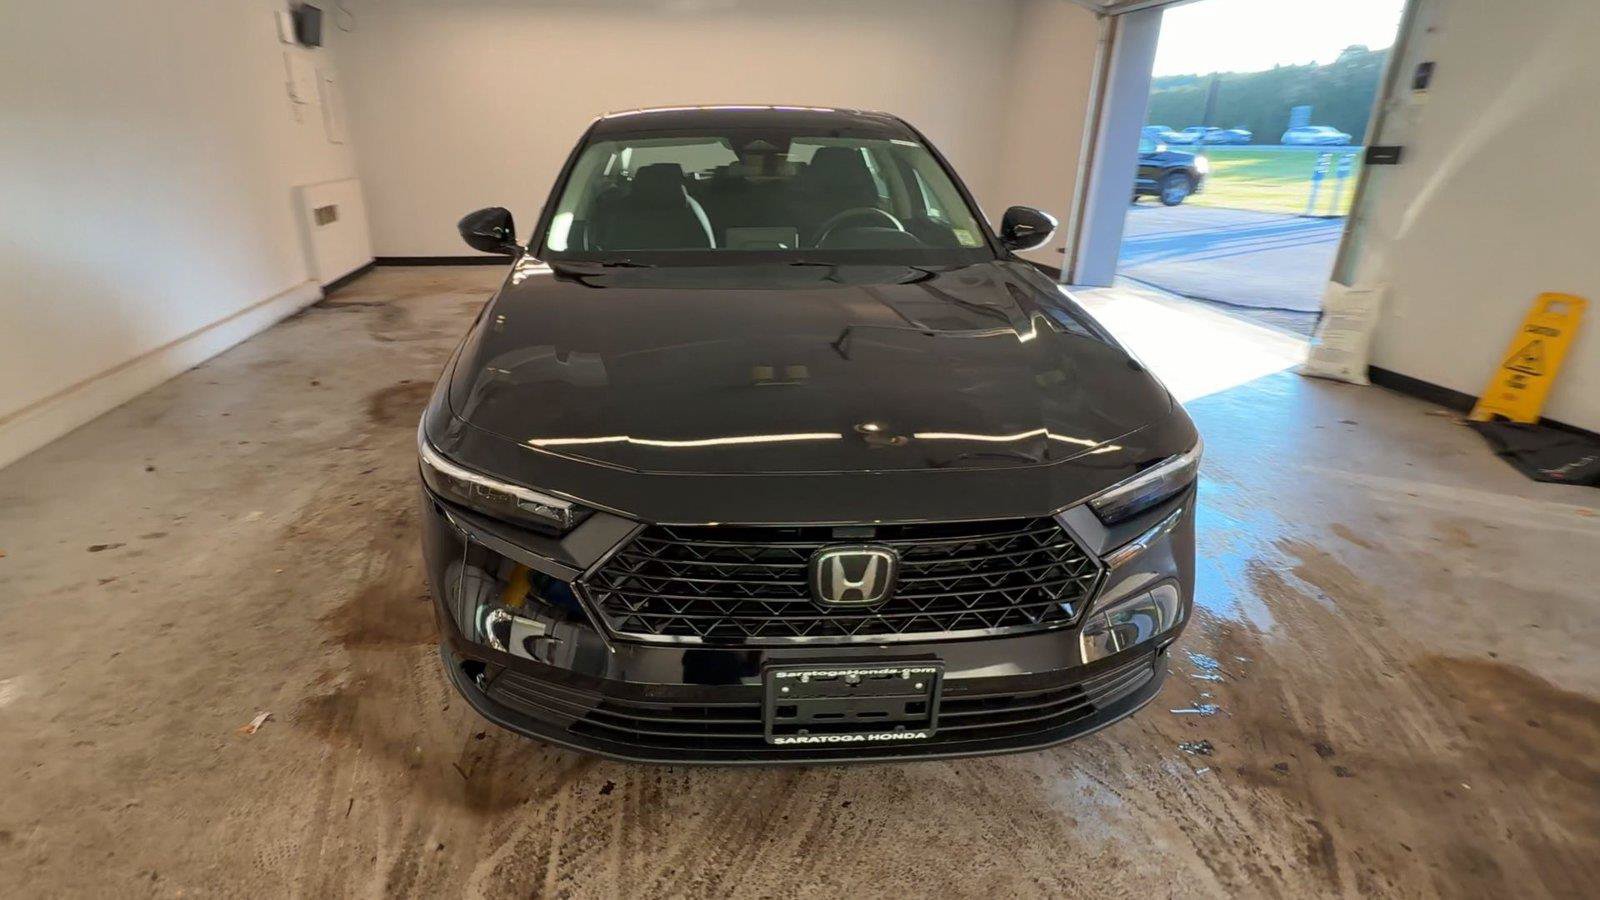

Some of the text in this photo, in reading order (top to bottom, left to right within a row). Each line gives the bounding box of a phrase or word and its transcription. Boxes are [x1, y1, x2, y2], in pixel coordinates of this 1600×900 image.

[776, 667, 936, 678] SaratogaHonda.com
[774, 732, 927, 745] SARATOGA HONDA
